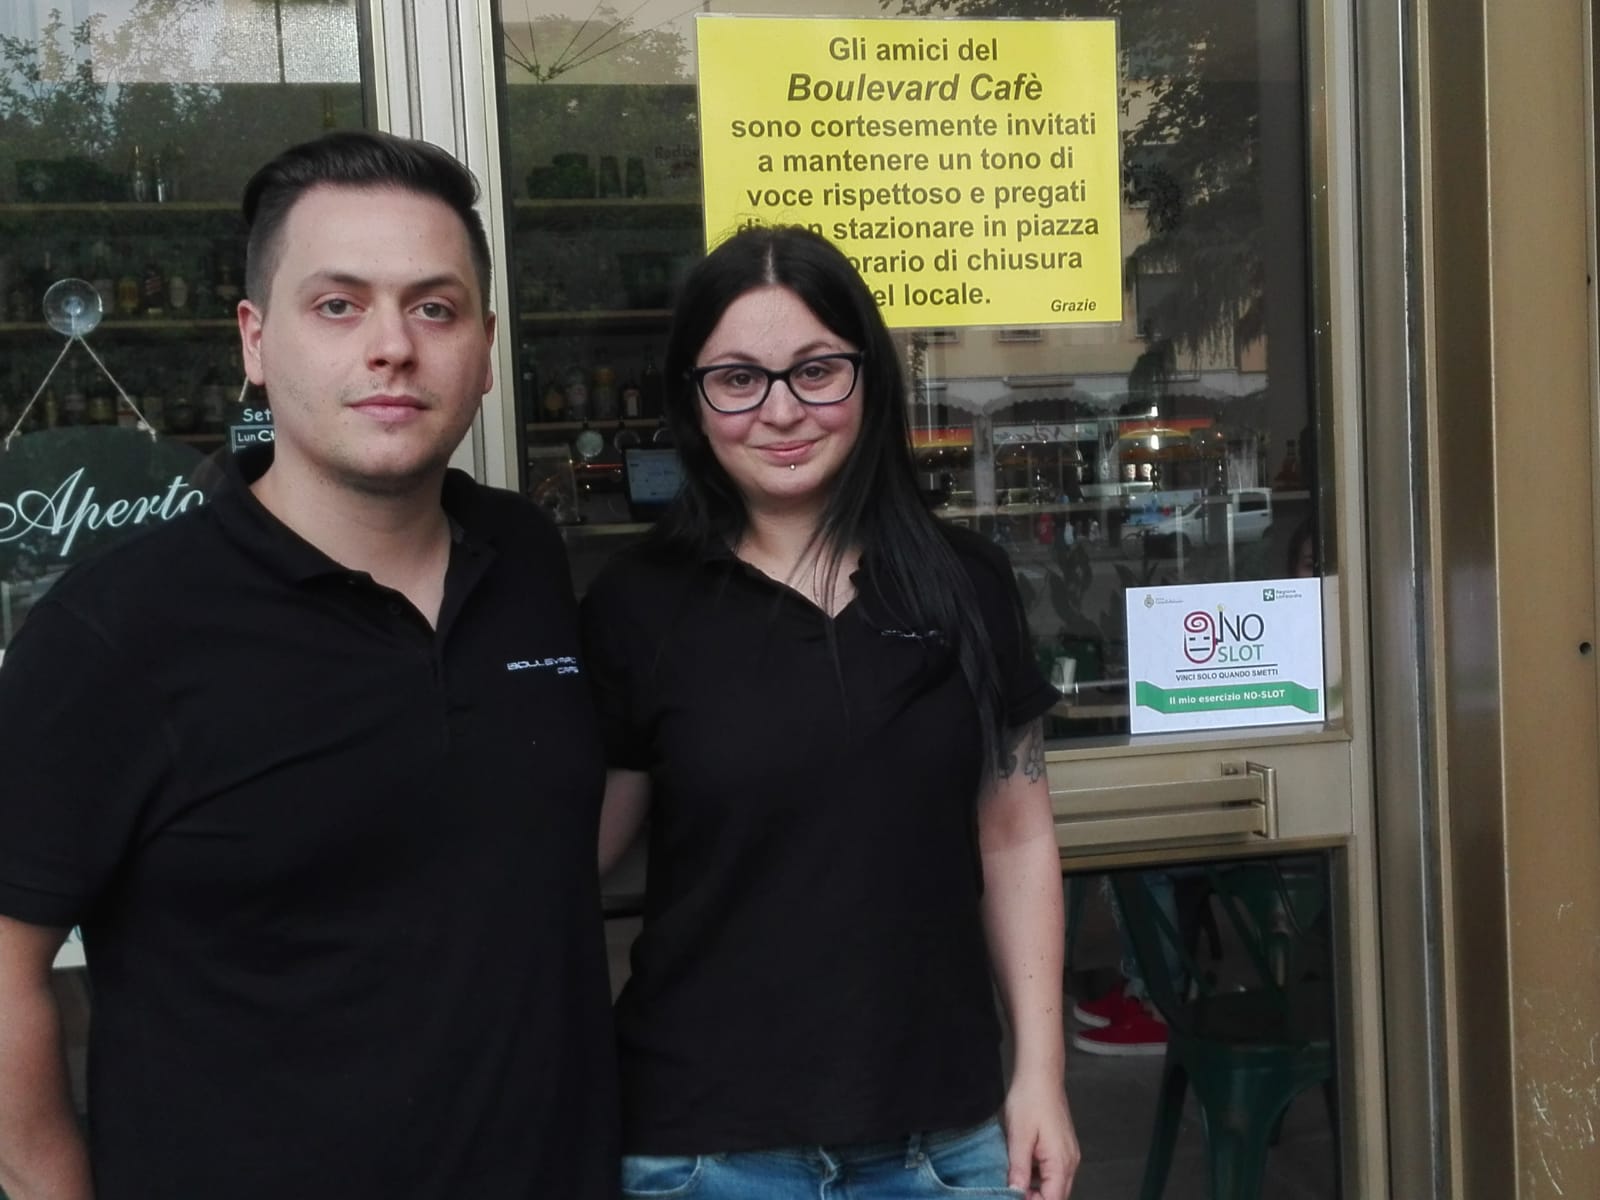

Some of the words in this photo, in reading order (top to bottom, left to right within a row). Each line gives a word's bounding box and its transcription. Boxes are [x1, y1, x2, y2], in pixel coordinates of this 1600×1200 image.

[829, 37, 866, 60] Gli
[877, 38, 948, 61] amici
[959, 38, 997, 61] del
[788, 74, 960, 101] Boulevard
[971, 73, 1042, 100] Cafè
[732, 120, 801, 137] sono
[811, 115, 997, 137] cortesemente
[1008, 112, 1095, 135] invitati
[759, 155, 773, 172] a
[784, 150, 928, 172] mantenere
[939, 153, 971, 170] un
[981, 148, 1041, 169] tono
[1050, 146, 1072, 169] di
[747, 189, 813, 206] voce
[824, 183, 961, 211] rispettoso
[971, 187, 984, 203] e
[995, 180, 1085, 209] pregati
[834, 216, 973, 240] stazionare
[984, 215, 1006, 237] in
[1017, 214, 1099, 242] piazza
[934, 249, 957, 271] di
[968, 248, 1082, 271] chiusura
[868, 283, 894, 306] el
[905, 282, 990, 306] locale.
[1051, 299, 1096, 312] Grazie
[1219, 611, 1265, 643] NO
[1218, 644, 1264, 663] SLOT
[1179, 696, 1196, 704] mio
[1199, 693, 1240, 702] esercizio
[1244, 690, 1285, 699] NO-SLOT
